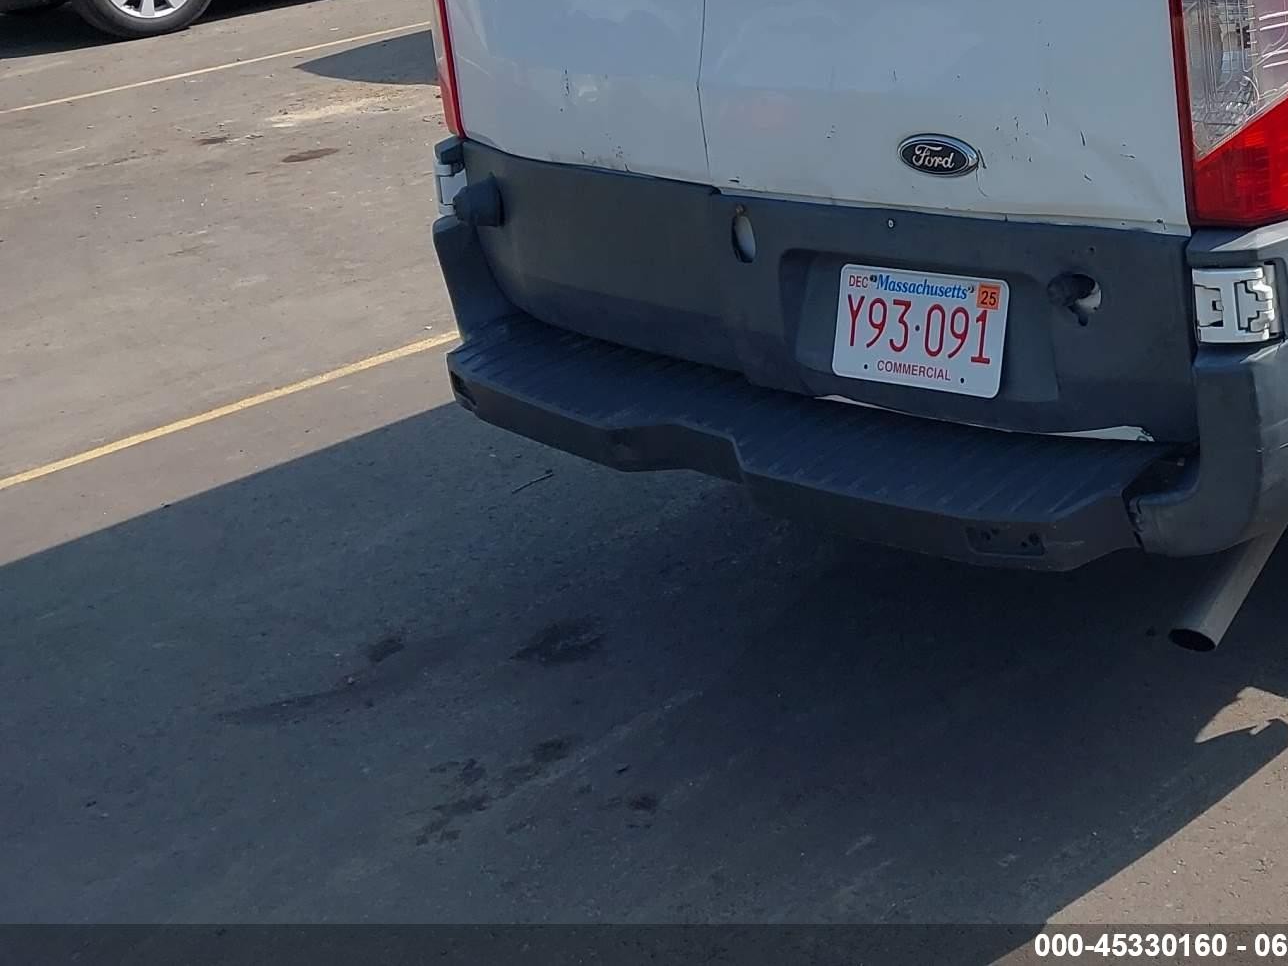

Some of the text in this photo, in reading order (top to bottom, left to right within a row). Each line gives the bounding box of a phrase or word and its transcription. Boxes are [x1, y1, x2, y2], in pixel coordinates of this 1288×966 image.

[912, 144, 956, 169] Ford
[848, 274, 869, 288] DEC
[876, 273, 968, 300] Massachusetts
[980, 290, 997, 306] 25
[877, 359, 952, 381] COMMERCIAL
